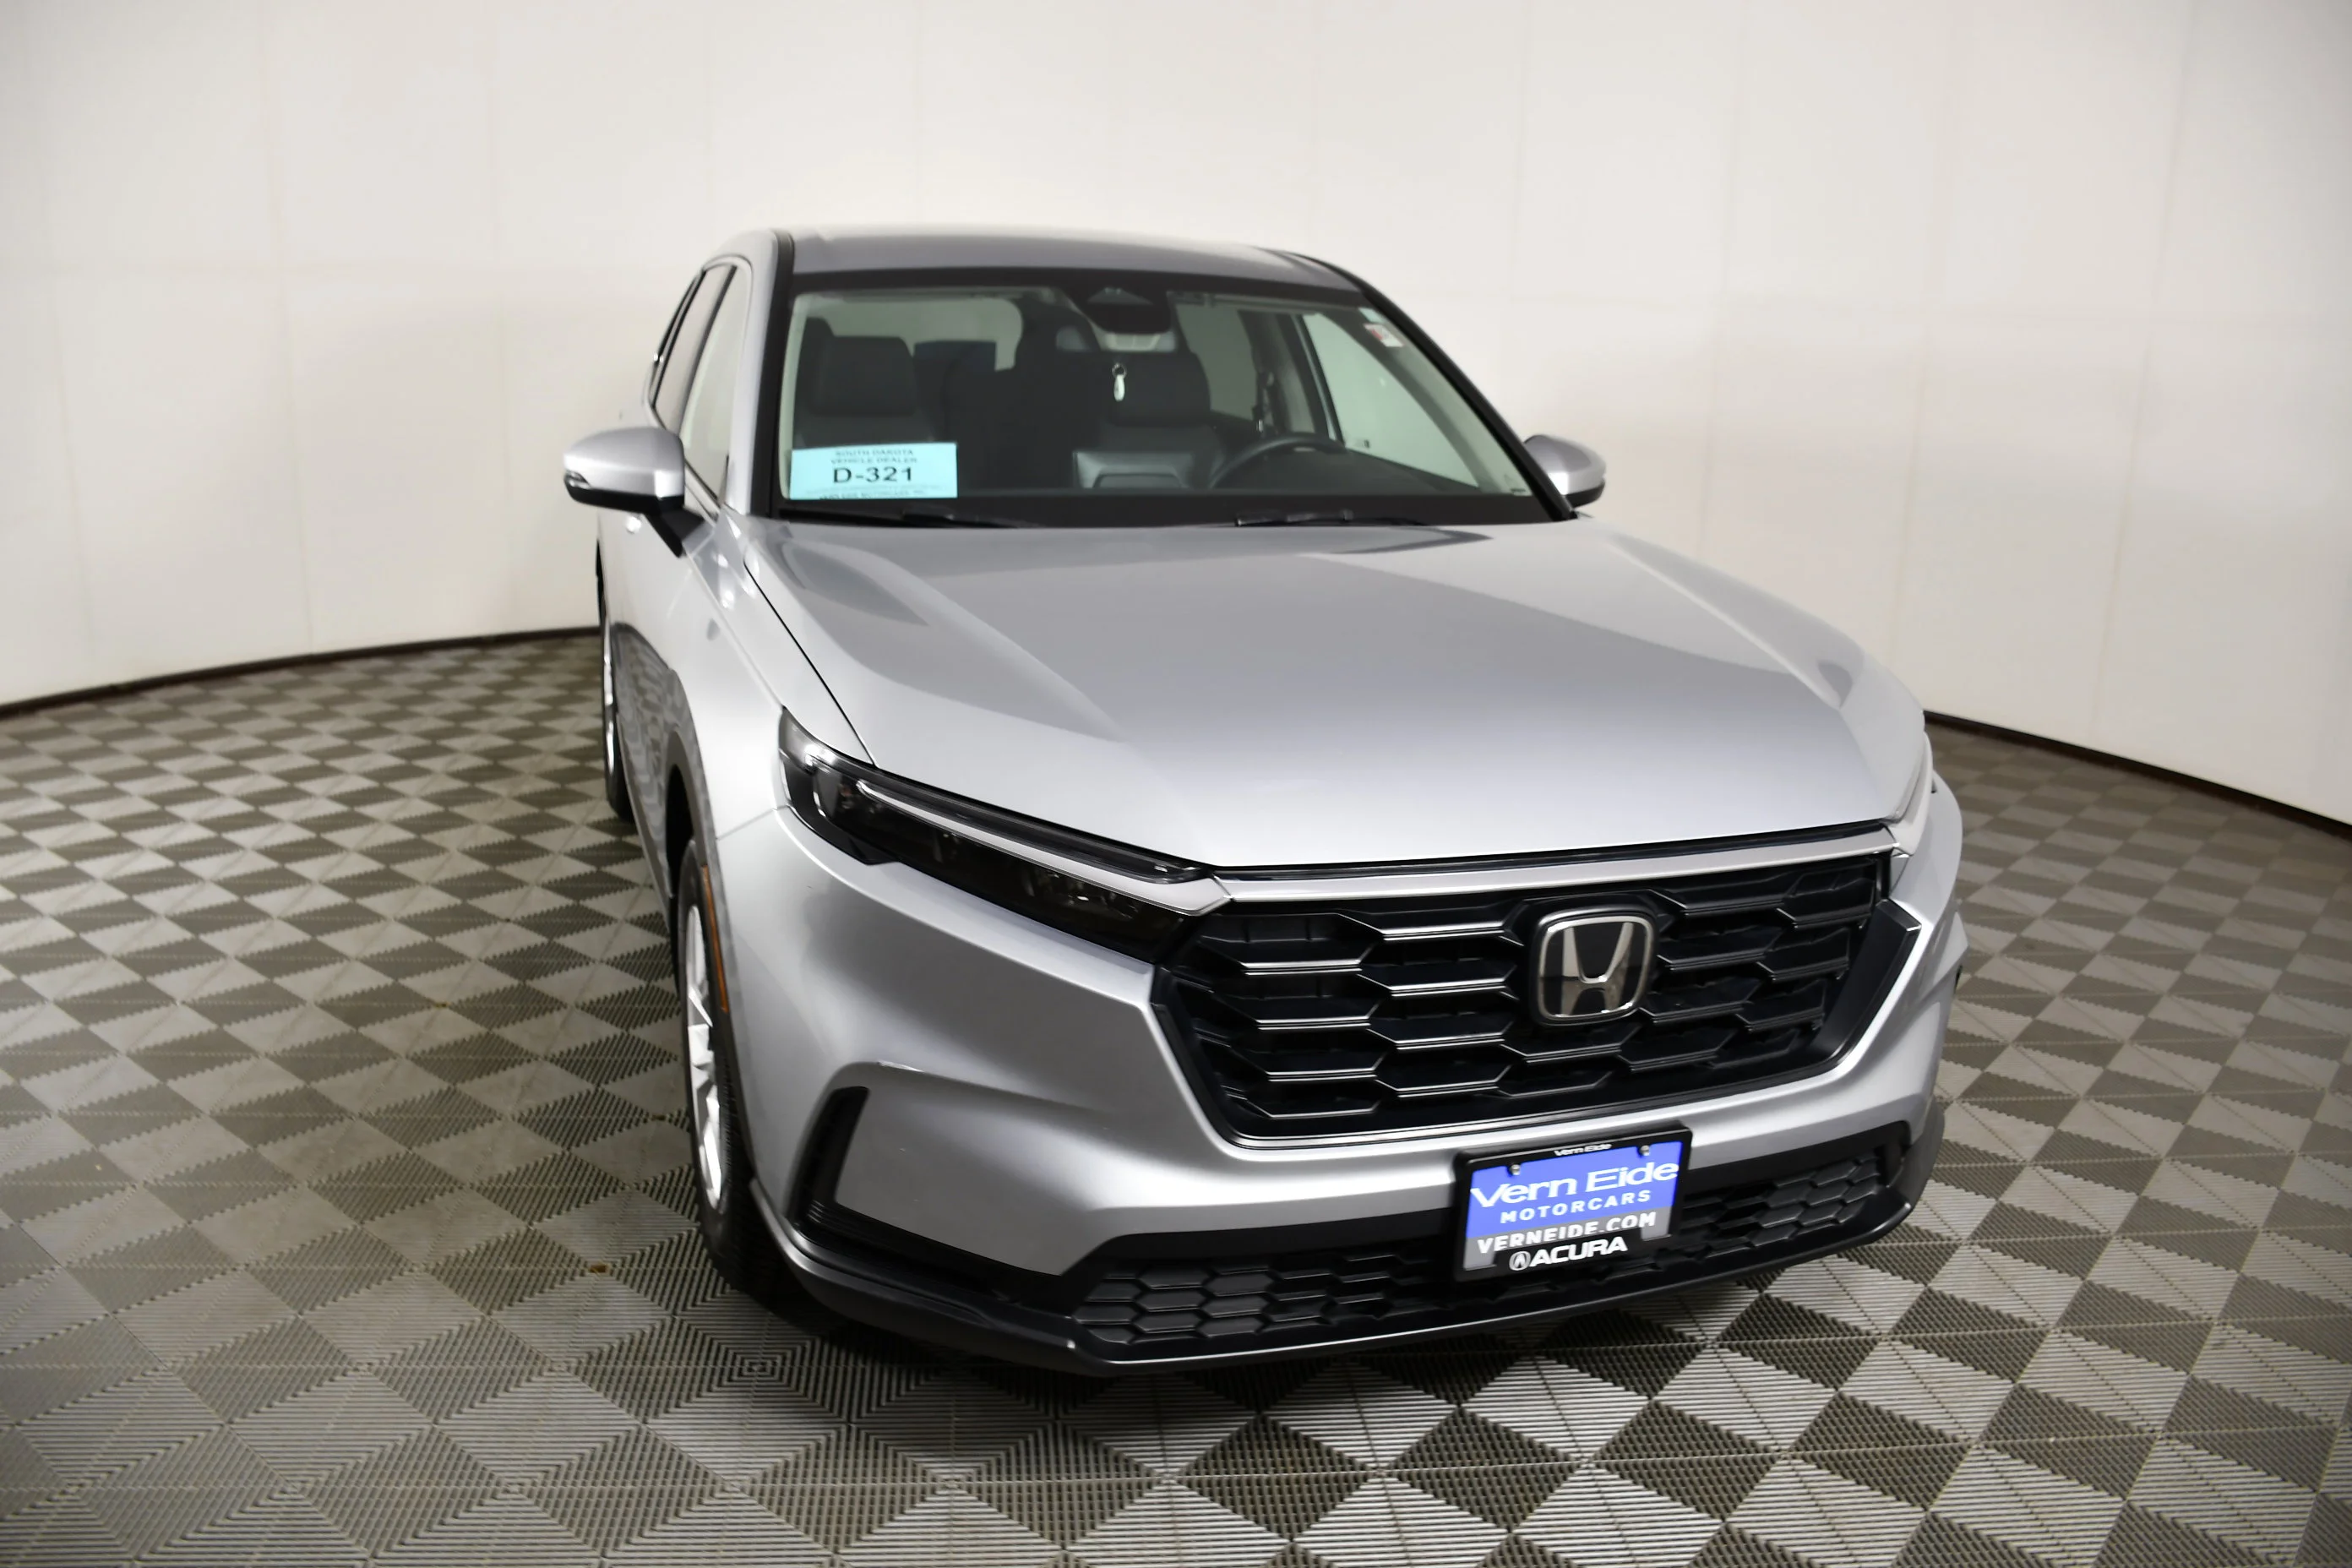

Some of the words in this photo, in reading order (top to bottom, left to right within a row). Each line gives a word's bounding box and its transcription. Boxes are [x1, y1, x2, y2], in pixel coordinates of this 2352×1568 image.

[833, 466, 912, 483] D-321
[1554, 1146, 1584, 1157] Vern
[1585, 1143, 1613, 1154] Eide
[1470, 1178, 1577, 1208] Vern
[1585, 1162, 1680, 1193] Eide
[1500, 1190, 1652, 1224] MOTORCARS
[1477, 1211, 1657, 1255] VERNEIDE.COM
[1529, 1236, 1629, 1267] ACURA
